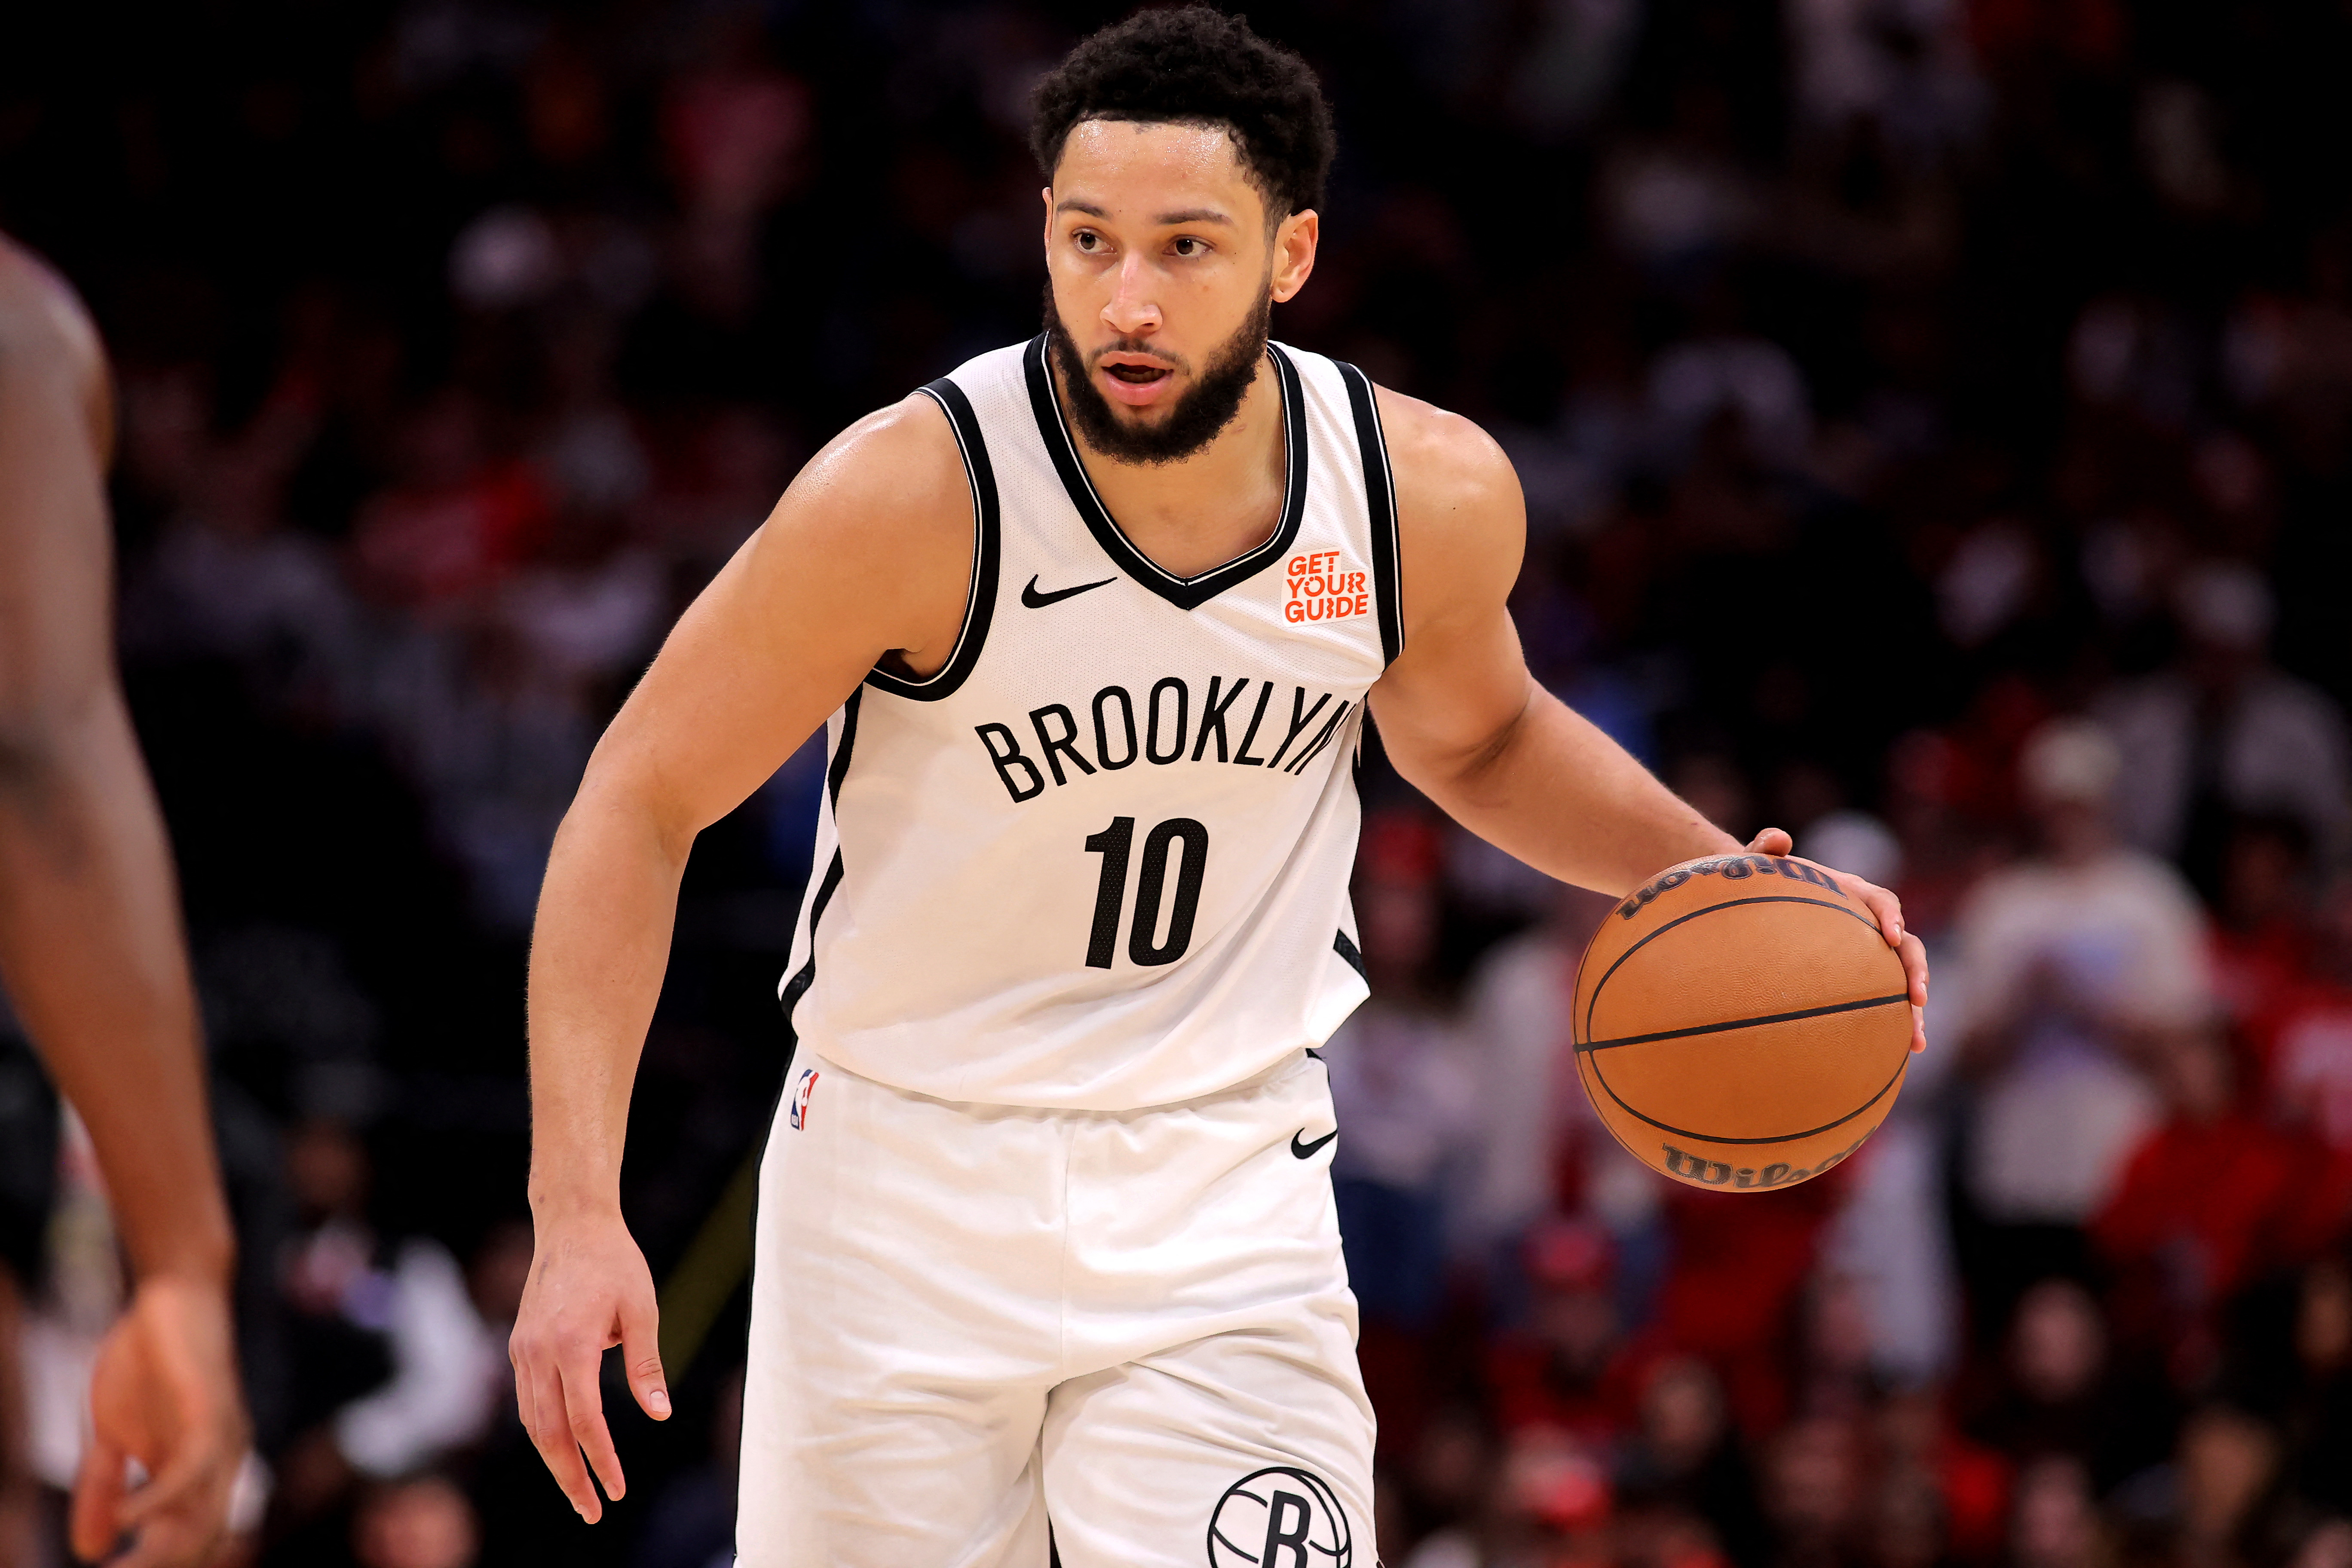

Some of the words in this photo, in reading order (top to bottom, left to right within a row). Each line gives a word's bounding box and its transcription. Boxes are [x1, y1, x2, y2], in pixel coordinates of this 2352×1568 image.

[1286, 572, 1366, 598] YOUR
[1288, 551, 1339, 576] GET
[1285, 594, 1368, 623] GUIDE
[974, 676, 1356, 803] BROOKLYN
[1085, 816, 1209, 969] 10
[1263, 1490, 1311, 1568] B
